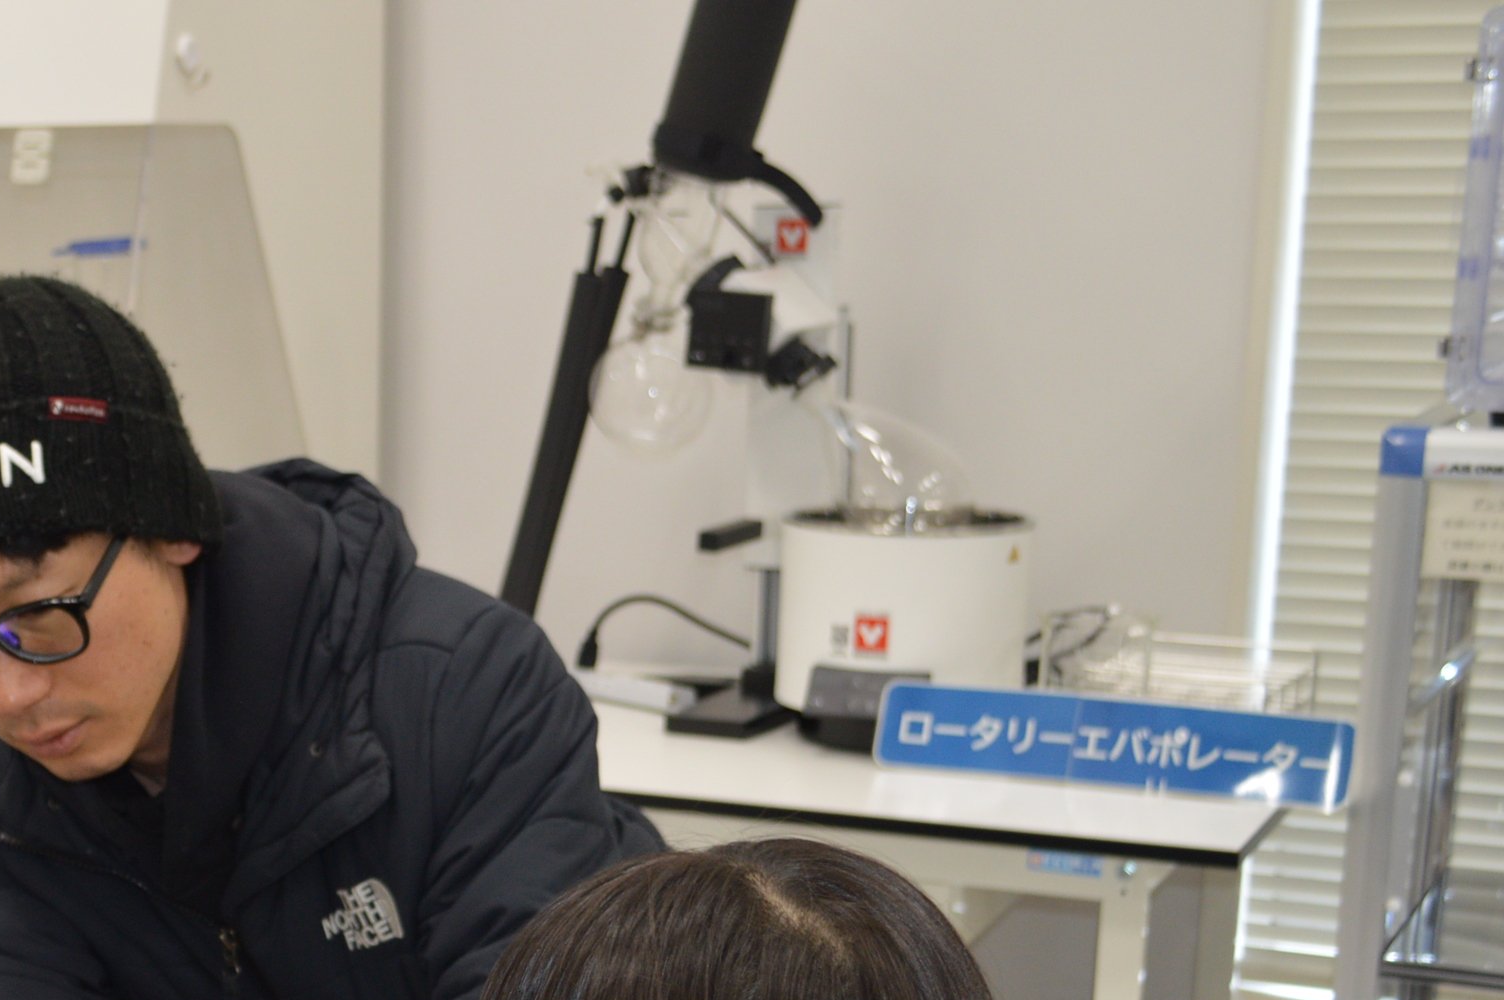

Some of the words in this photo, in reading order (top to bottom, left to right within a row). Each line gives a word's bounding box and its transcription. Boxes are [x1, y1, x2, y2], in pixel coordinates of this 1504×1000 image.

[898, 710, 1333, 773] ロータリーエバポレーター
[336, 881, 377, 912] THE
[321, 900, 387, 940] NORTH
[344, 921, 396, 951] FACE
